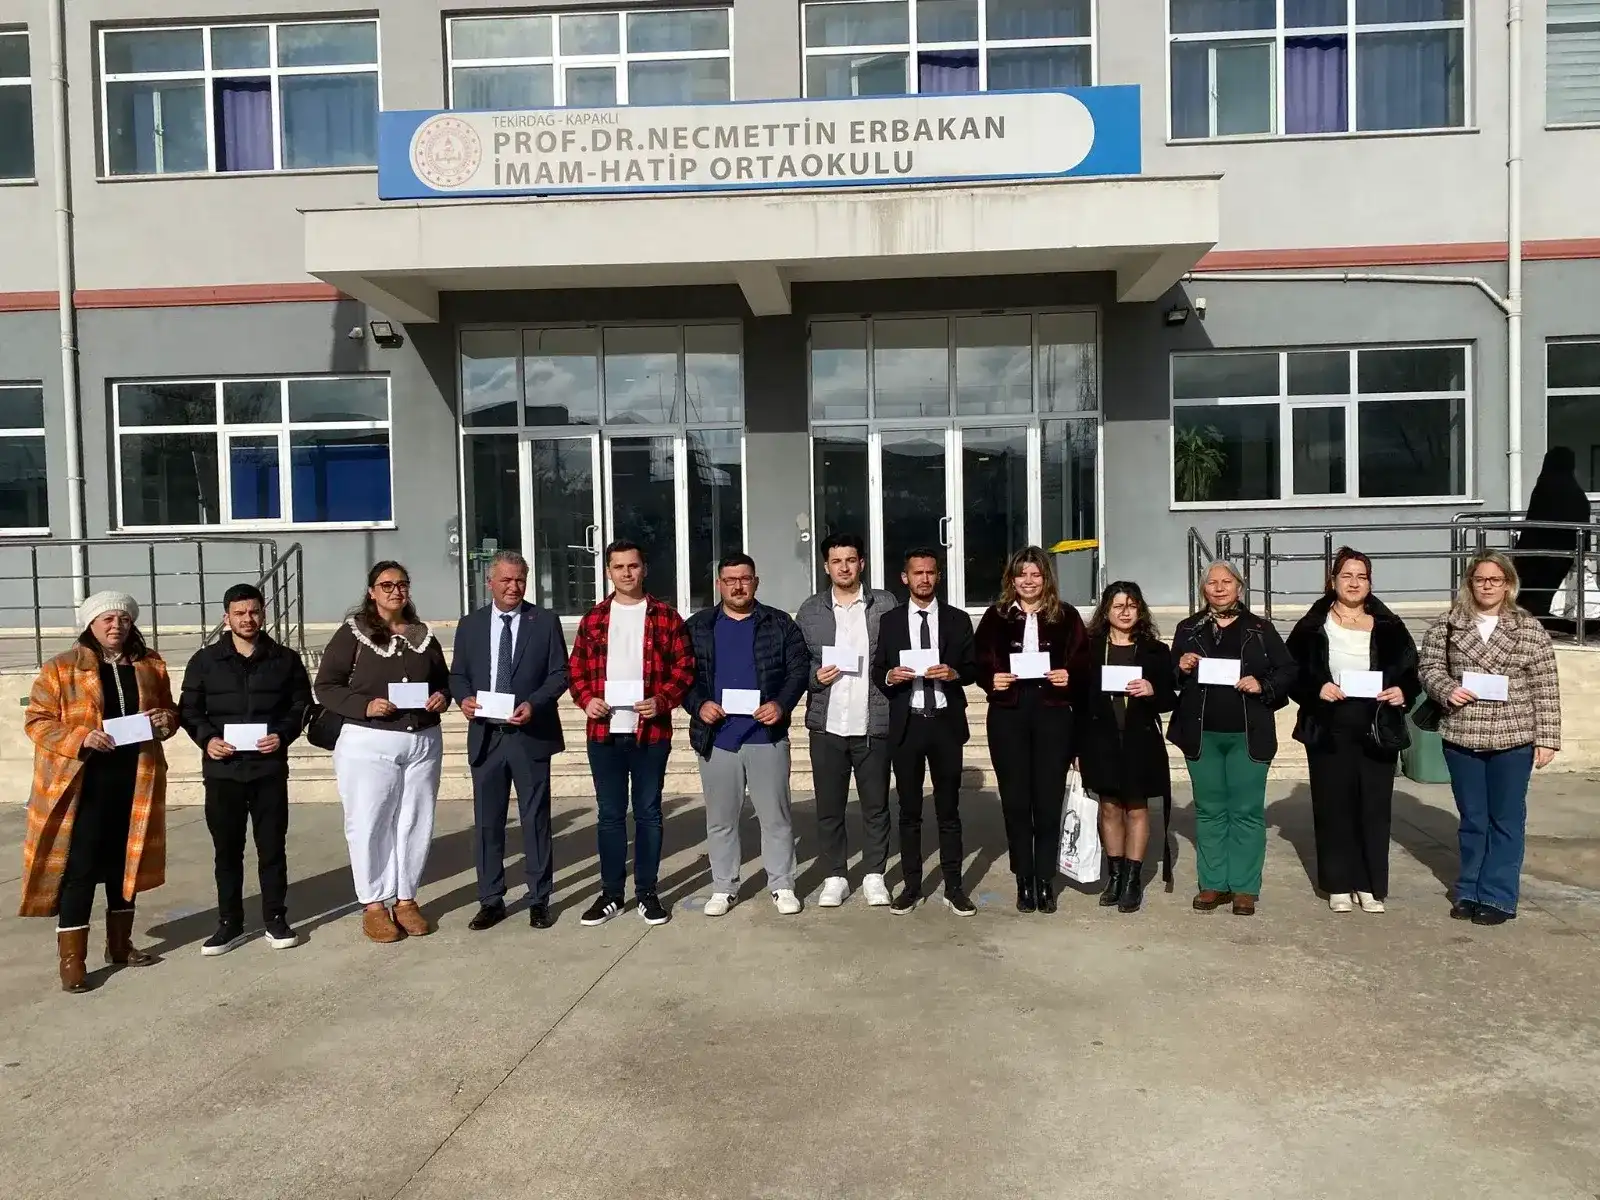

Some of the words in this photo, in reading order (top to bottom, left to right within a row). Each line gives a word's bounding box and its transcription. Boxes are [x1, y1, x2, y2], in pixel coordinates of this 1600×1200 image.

[492, 113, 555, 128] TEKİRDAĞ
[566, 112, 620, 125] KAPAKLI
[850, 115, 1006, 143] ERBAKAN
[494, 153, 698, 186] İMAM-HATİP
[709, 150, 914, 181] ORTAOKULU
